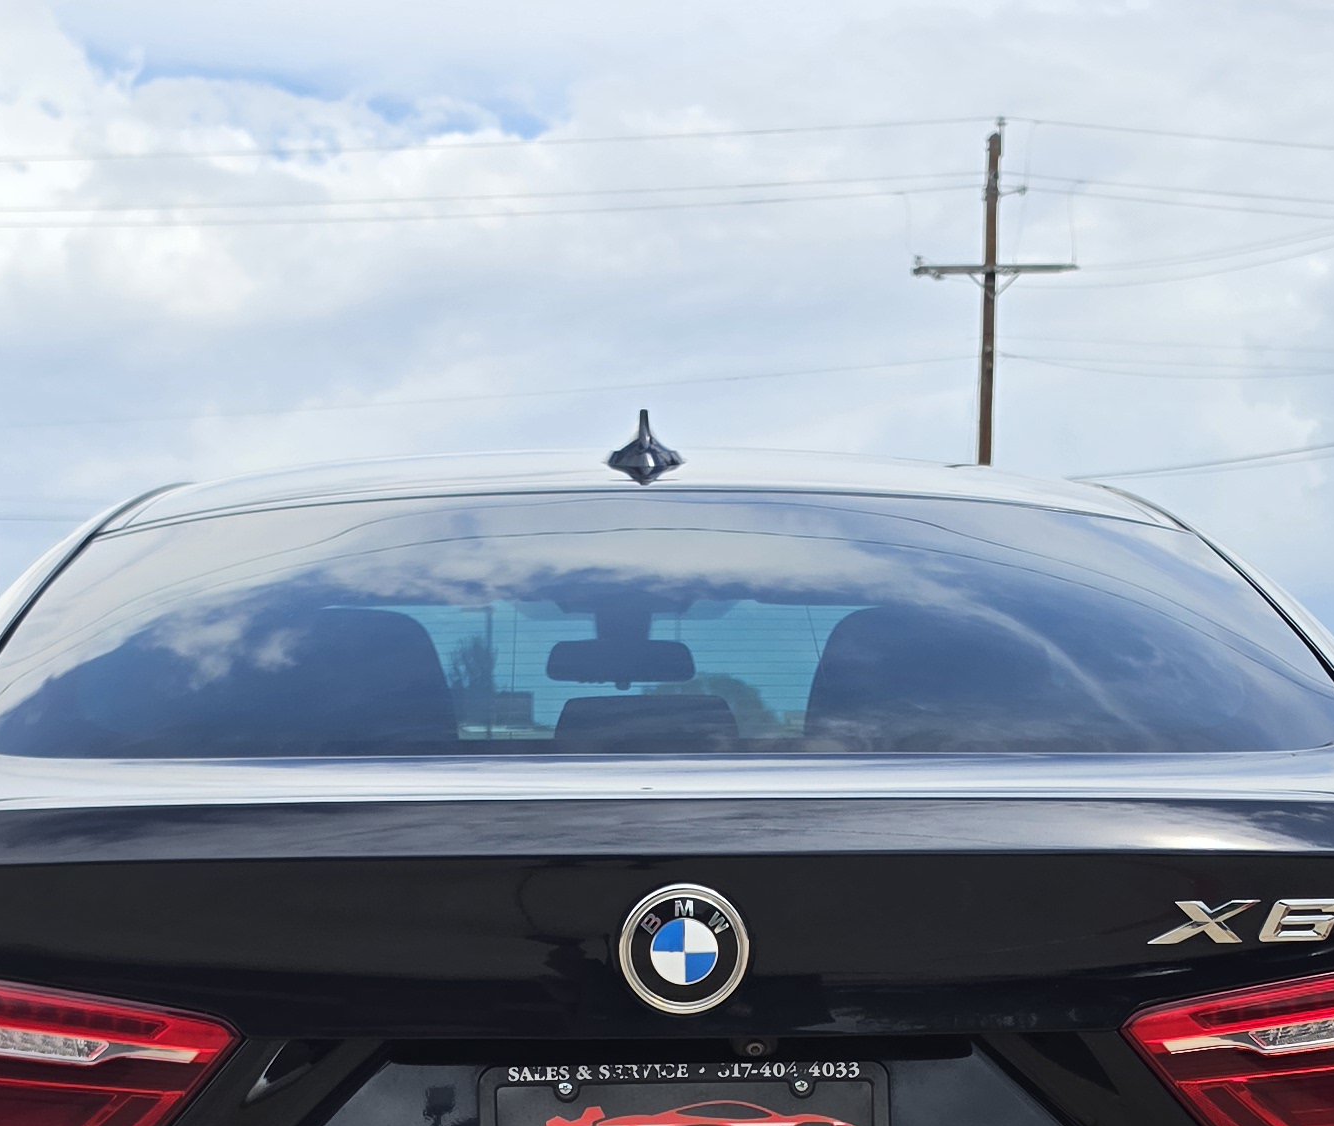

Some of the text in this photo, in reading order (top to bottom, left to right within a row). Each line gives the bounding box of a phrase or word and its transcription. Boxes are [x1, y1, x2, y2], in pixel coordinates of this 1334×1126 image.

[640, 899, 729, 935] BMW
[508, 1061, 860, 1082] SALES & SERVICE 17-4044033
